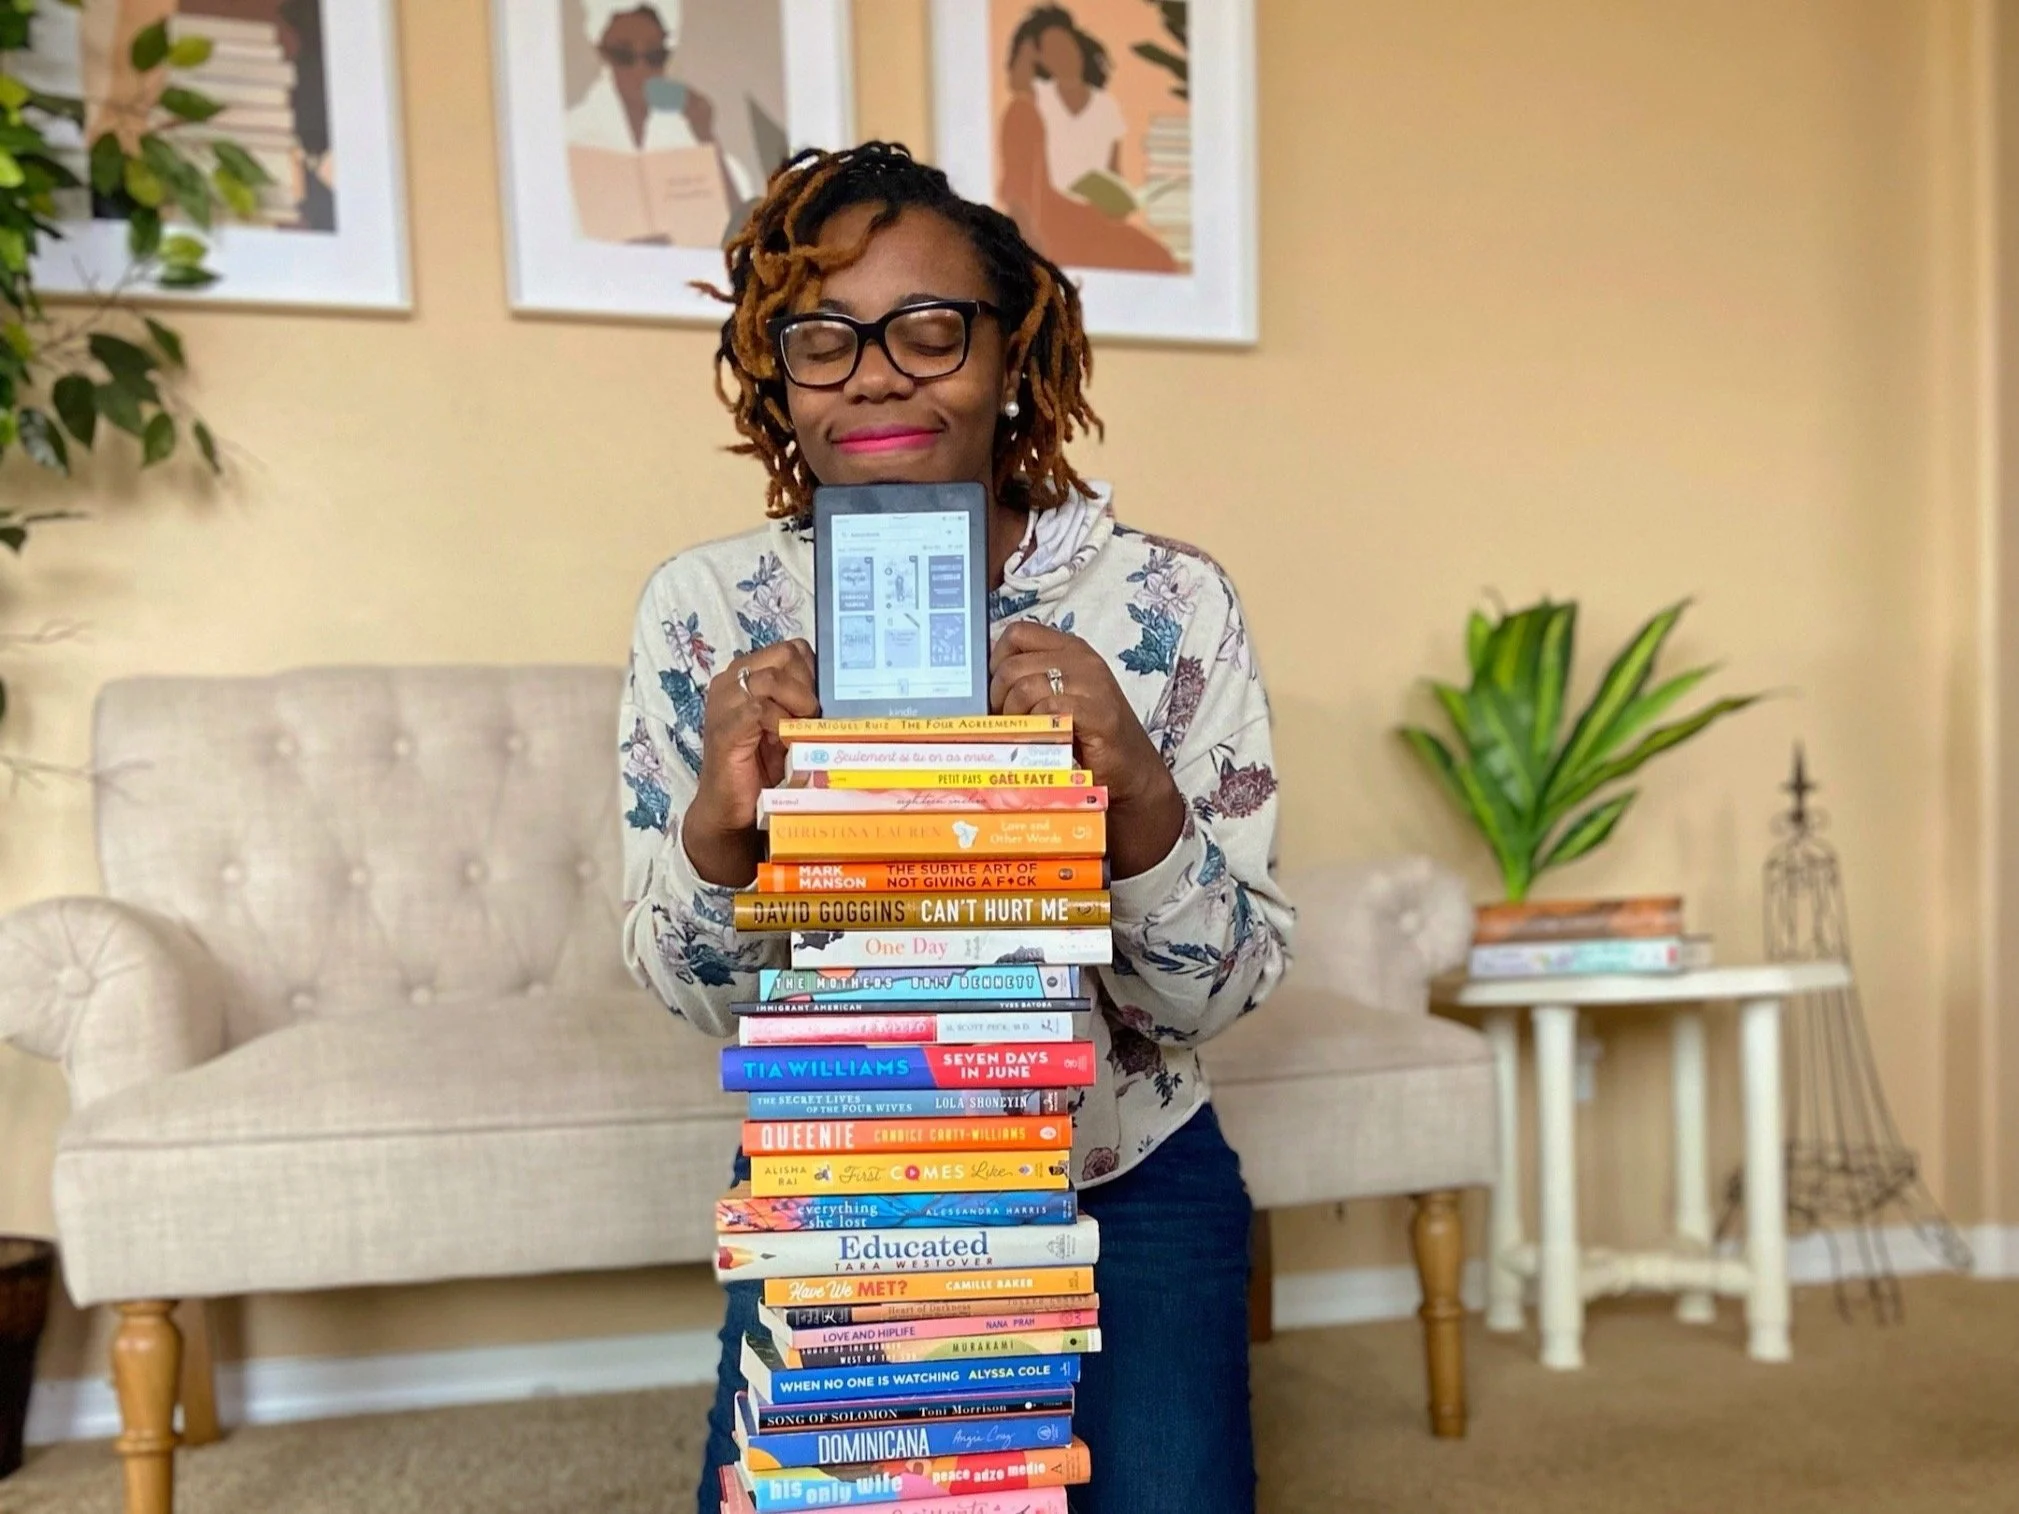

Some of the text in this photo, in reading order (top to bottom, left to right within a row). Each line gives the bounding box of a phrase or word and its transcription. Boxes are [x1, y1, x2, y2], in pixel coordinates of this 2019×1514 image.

[888, 705, 918, 717] kindle
[817, 721, 858, 730] MIGUEL
[865, 720, 889, 730] RUIZ
[901, 719, 920, 729] THE
[926, 719, 953, 729] FOUR
[958, 718, 1028, 729] AGREEMENTS
[833, 748, 897, 764] Seulement
[899, 750, 910, 763] si
[912, 751, 926, 763] tu
[928, 752, 942, 763] en
[938, 773, 960, 785] PETIT
[962, 773, 982, 784] PAYS
[1024, 773, 1054, 785] FAYE
[776, 824, 940, 840] CHRISTINA LAUREN
[1001, 819, 1050, 831] Love and
[990, 832, 1062, 844] Other Words
[799, 865, 844, 877] MARK
[886, 862, 1038, 875] THE SUBTLE ART OF
[799, 876, 867, 889] MANSON
[886, 876, 919, 888] NOT
[923, 875, 977, 888] GIVING
[981, 876, 993, 887] A
[753, 897, 1069, 923] DAVID GOGGINS CAN'T HURT ME
[865, 936, 949, 960] One Day
[775, 975, 1035, 990] THE MOTHERS BRIT BENNETT
[756, 1004, 810, 1012] IMMIGRANT
[813, 1003, 862, 1012] AMERICAN
[1000, 1001, 1019, 1009] YVES
[943, 1051, 1049, 1066] SEVEN DAYS
[743, 1058, 910, 1079] TIA WILLIAMS
[960, 1065, 1031, 1080] IN JUNE
[757, 1094, 861, 1106] THE SECRET LIVES
[935, 1096, 965, 1109] LOLA
[969, 1095, 1028, 1109] SHONEYIN
[806, 1102, 913, 1114] OF THE FOUR WIVES
[761, 1123, 855, 1150] QUEENIE
[764, 1166, 807, 1175] ALISHA
[839, 1165, 886, 1184] First
[971, 1160, 1013, 1180] Like
[778, 1177, 798, 1186] RAI
[797, 1200, 1048, 1217] everything ALESSANDRA HARRIS
[808, 1214, 867, 1229] she lost
[838, 1230, 990, 1261] Educated
[834, 1257, 993, 1272] TARA WESTOVER
[788, 1278, 1034, 1300] Have We MET? CAMILLE BAKER
[822, 1318, 1036, 1343] LOVE AND HIPLIFE NANA PRAH
[839, 1354, 862, 1365] WEST
[865, 1354, 877, 1364] OF
[952, 1339, 1014, 1353] MURAKAMI
[779, 1378, 821, 1394] WHEN
[823, 1377, 844, 1390] NO
[846, 1376, 875, 1388] ONE
[878, 1374, 890, 1387] IS
[892, 1370, 960, 1386] WATCHING
[968, 1366, 1014, 1381] ALYSSA
[1017, 1364, 1051, 1377] COLE
[766, 1403, 1008, 1427] SONG OF SOLOMON Toni Morrison
[817, 1426, 931, 1465] DOMINICANA
[952, 1427, 983, 1449] Angie
[768, 1478, 803, 1500] his
[805, 1481, 852, 1505] only
[856, 1471, 904, 1496] wife
[931, 1467, 971, 1486] peace
[1007, 1460, 1047, 1477] medie
